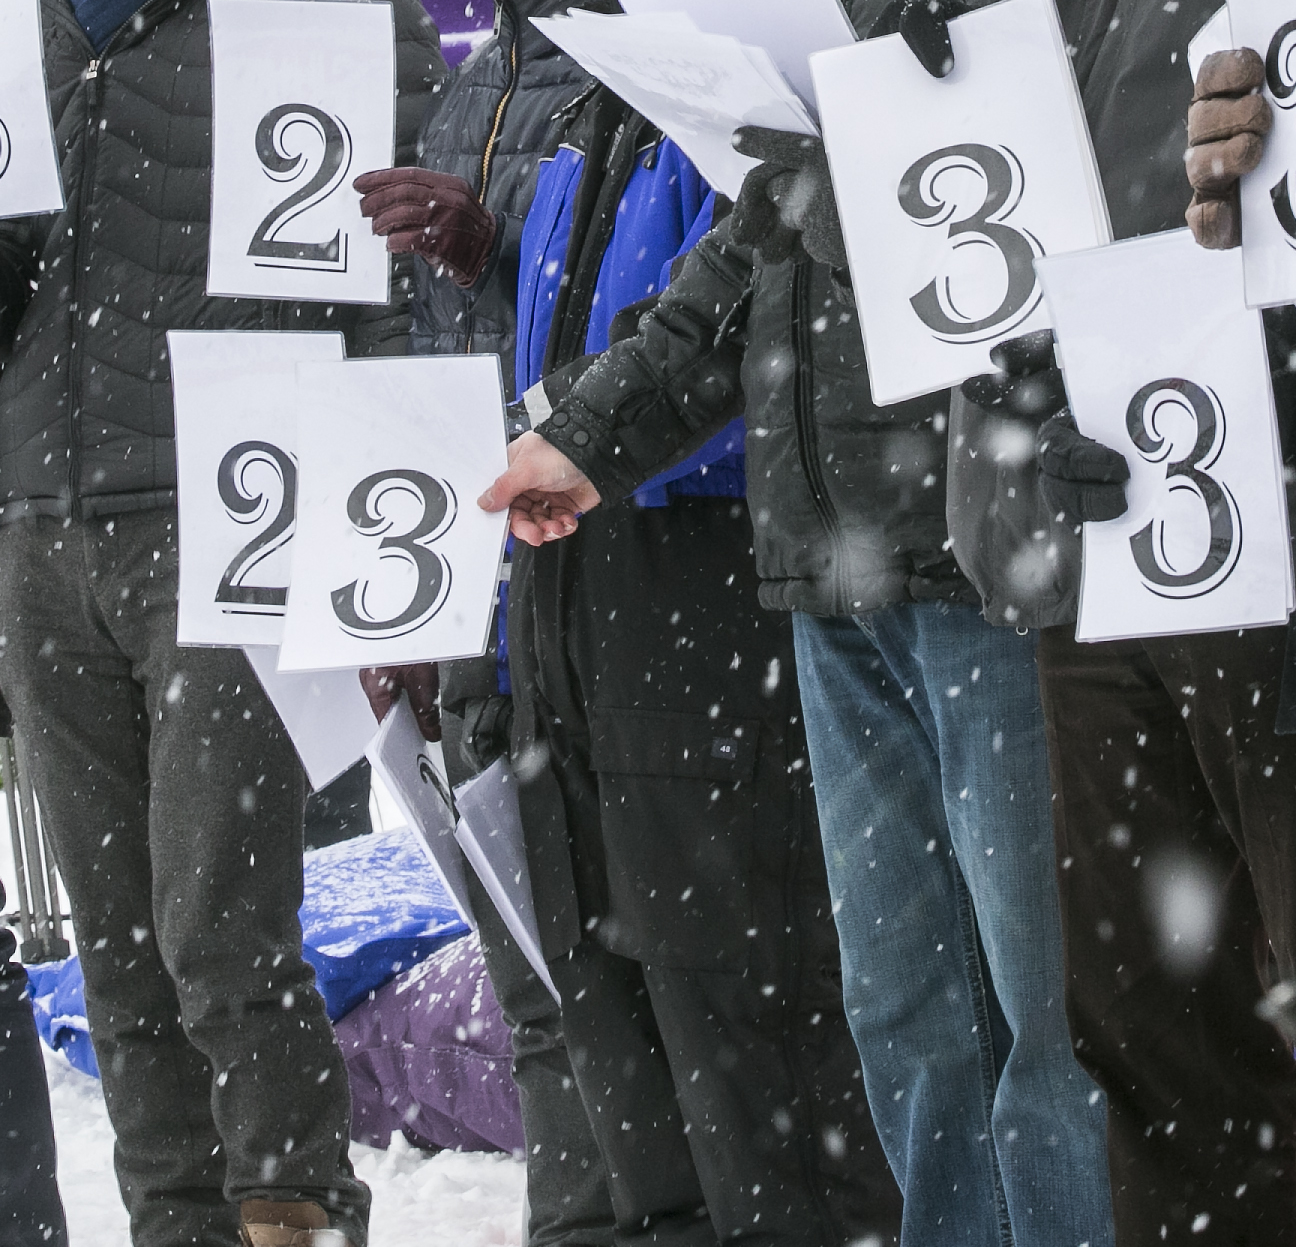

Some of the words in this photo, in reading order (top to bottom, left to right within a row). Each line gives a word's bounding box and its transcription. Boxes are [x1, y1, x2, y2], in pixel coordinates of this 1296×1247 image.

[246, 102, 352, 273] 2
[897, 142, 1046, 345] 3
[214, 439, 297, 616] 2
[330, 468, 457, 640] 3
[1125, 377, 1243, 599] 3
